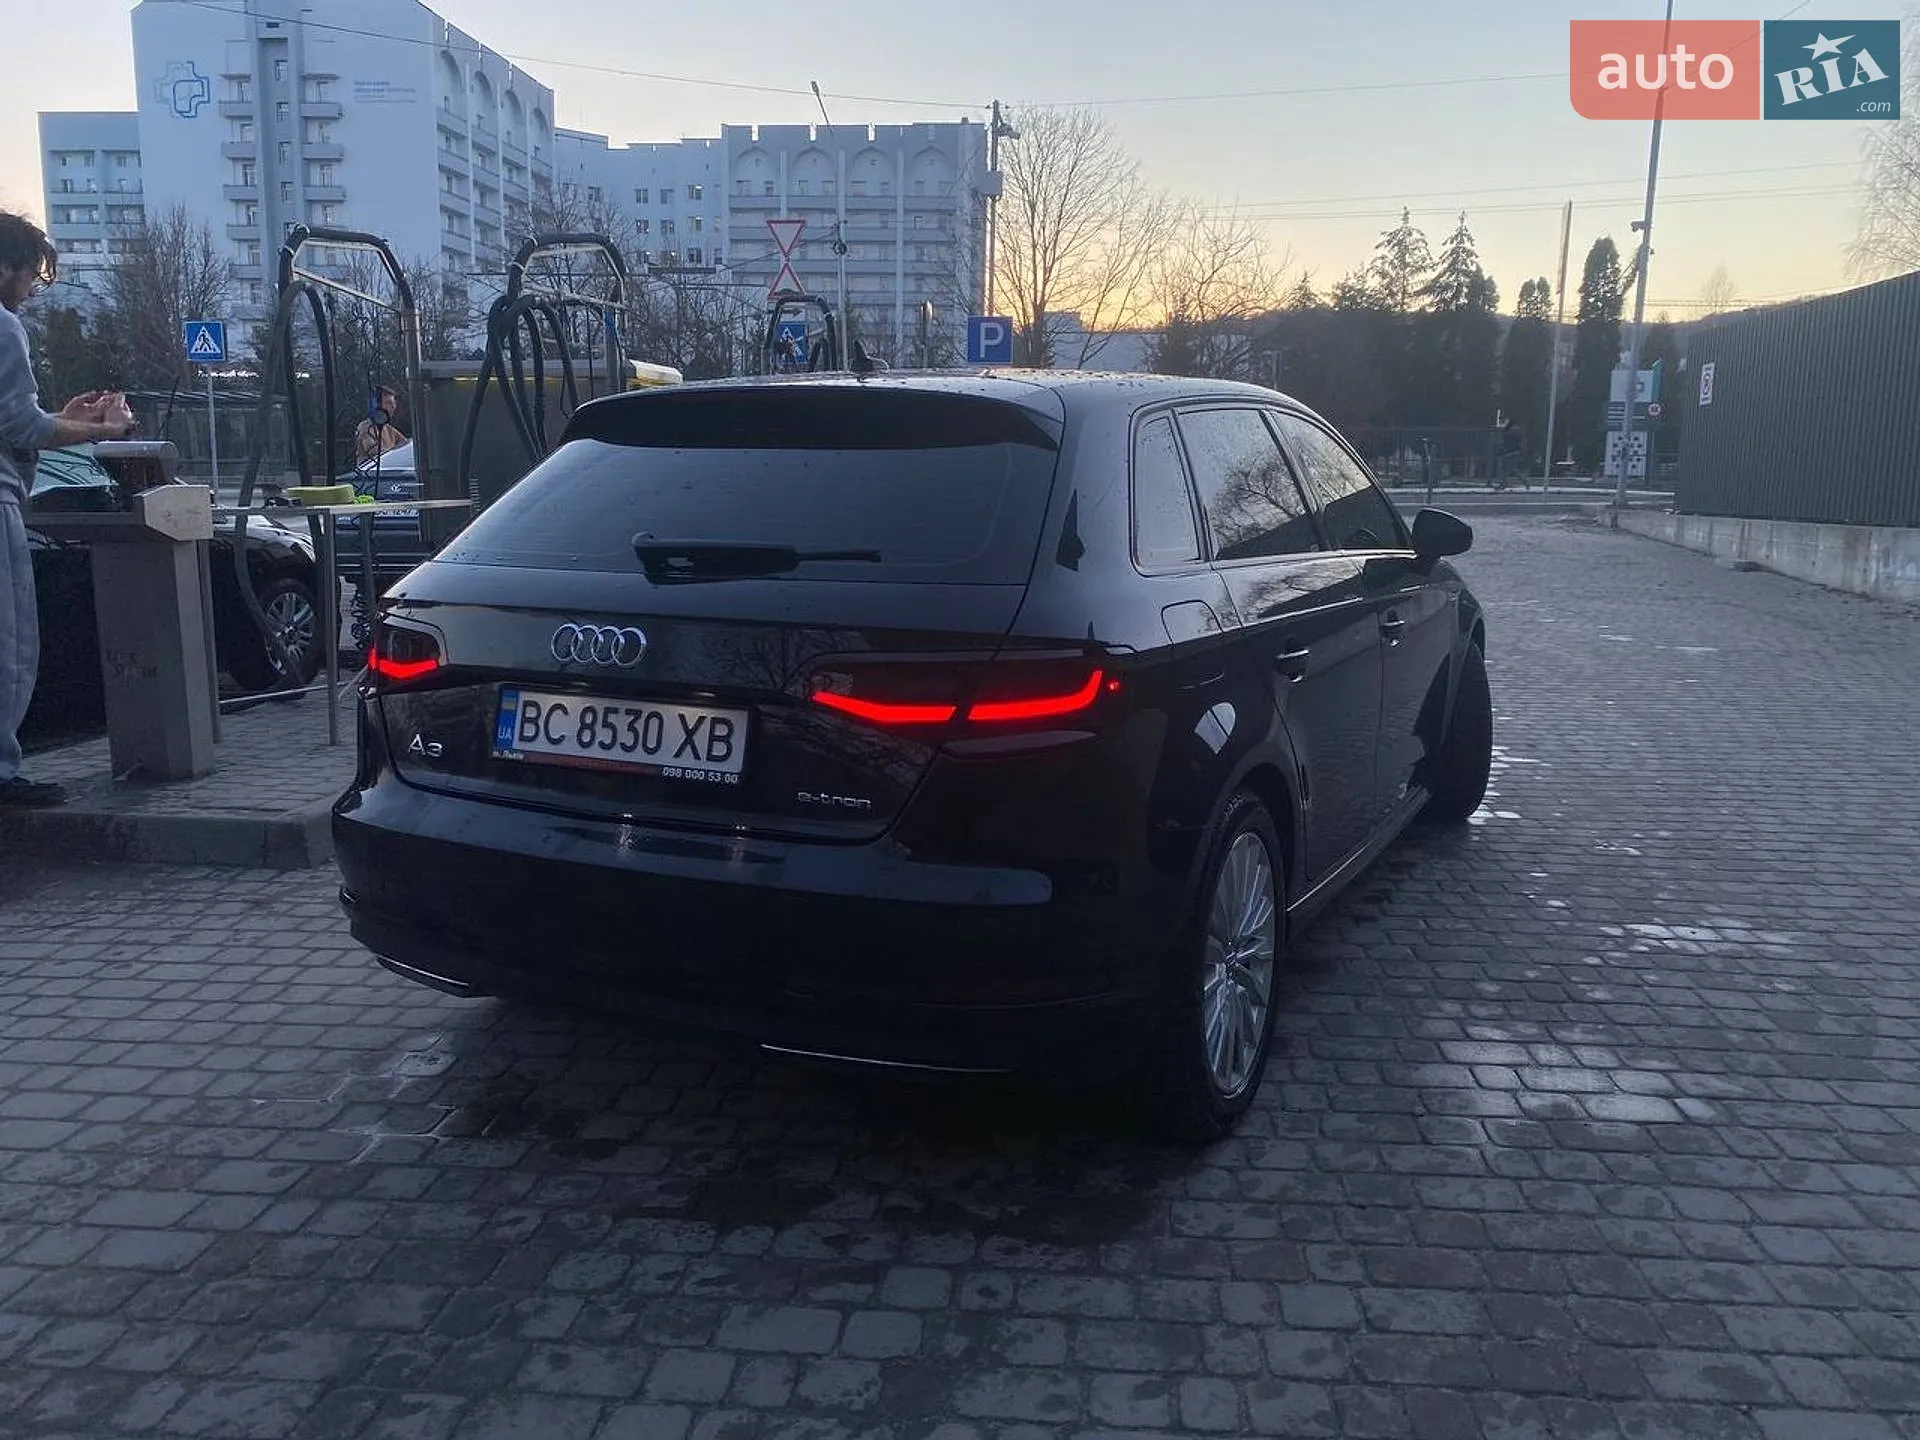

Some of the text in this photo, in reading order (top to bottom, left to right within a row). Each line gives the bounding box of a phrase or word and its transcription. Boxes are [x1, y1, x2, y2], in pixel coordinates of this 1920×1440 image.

[980, 322, 1004, 358] P
[408, 733, 442, 757] A3
[497, 726, 513, 741] UA
[518, 700, 735, 762] BC 8530 XB
